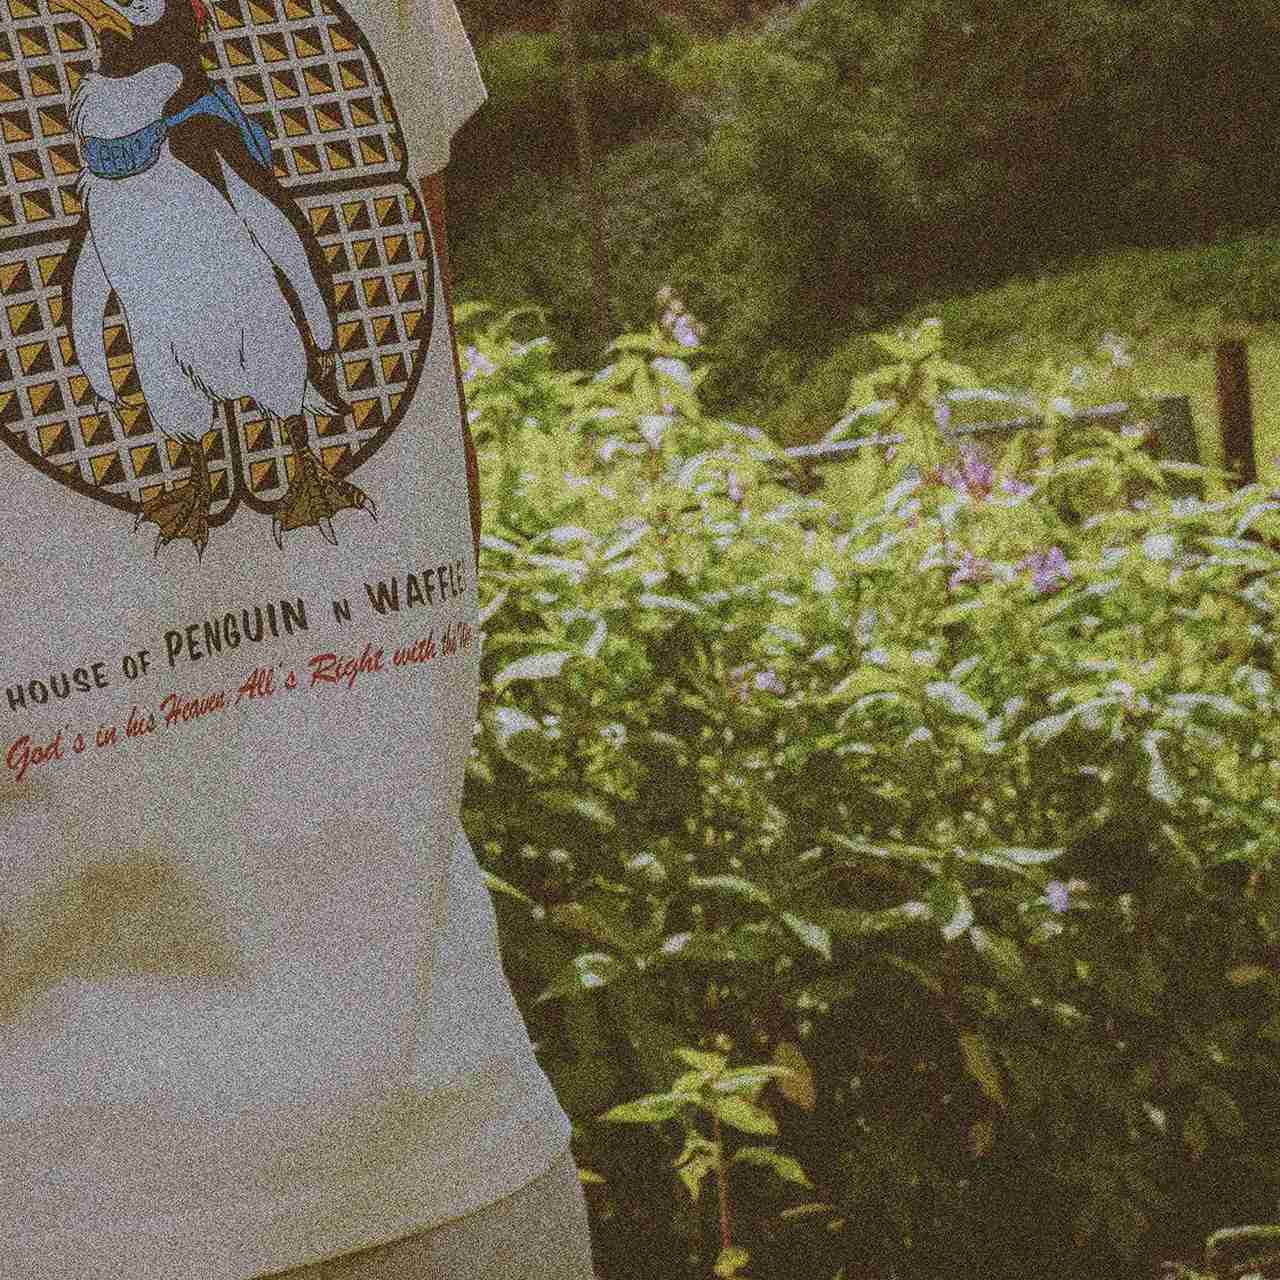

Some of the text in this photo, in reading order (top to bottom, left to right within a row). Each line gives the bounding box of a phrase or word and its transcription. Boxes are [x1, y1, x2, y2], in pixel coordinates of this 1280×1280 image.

[6, 662, 110, 711] HOUSE
[122, 650, 152, 680] OF
[163, 597, 308, 668] PENGUIN
[6, 723, 87, 785] God's
[95, 723, 118, 748] in
[125, 705, 156, 738] his
[308, 640, 385, 689] Right
[392, 627, 437, 666] with
